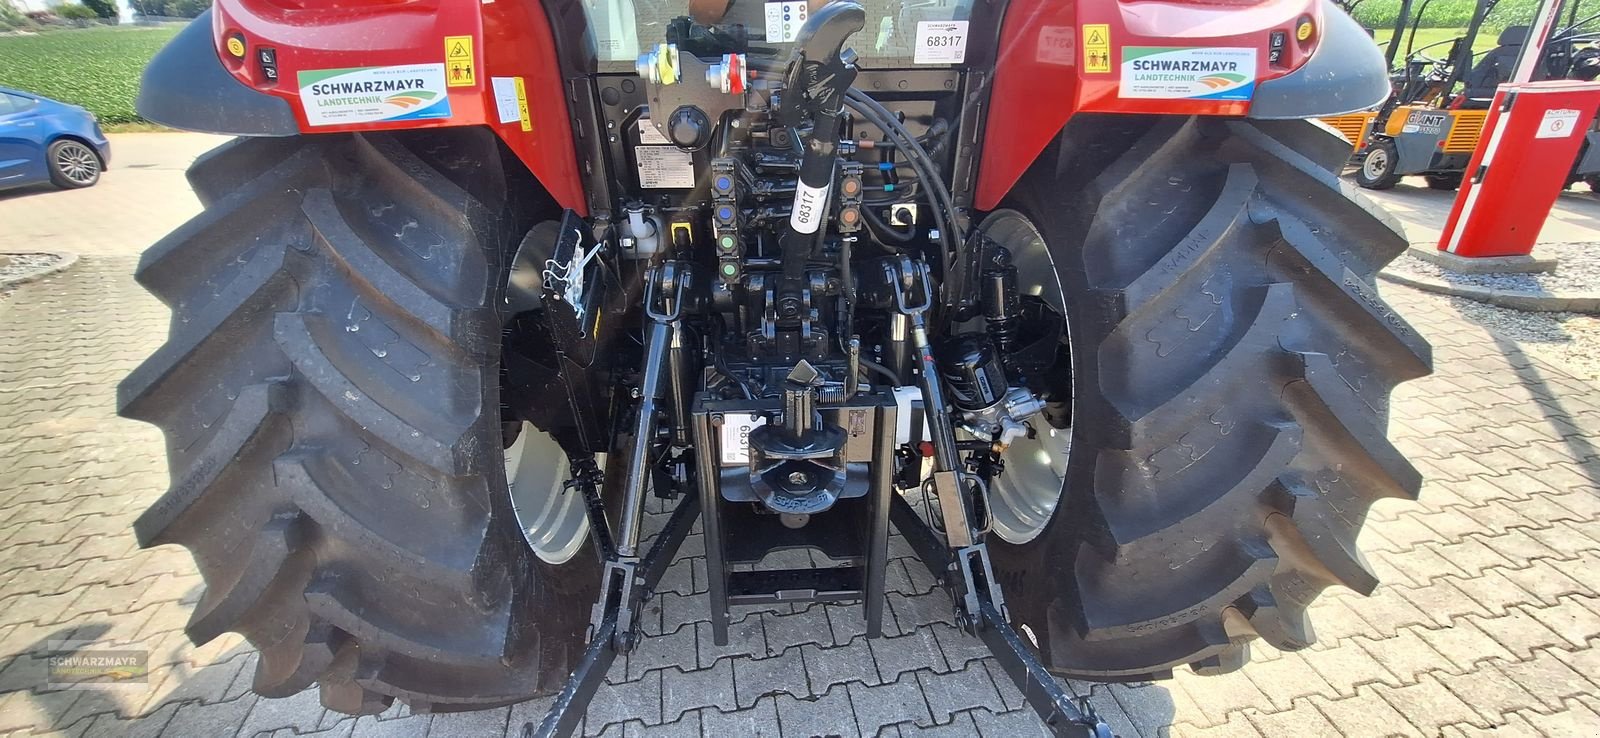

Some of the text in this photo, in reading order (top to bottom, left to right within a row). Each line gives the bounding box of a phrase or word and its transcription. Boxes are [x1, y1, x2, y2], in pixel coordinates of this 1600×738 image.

[927, 36, 961, 46] 68317
[1133, 60, 1237, 71] SCHWARZMAYR
[312, 79, 424, 96] SCHWARZMAYR
[317, 95, 382, 107] LANDTECHNIK
[798, 190, 814, 224] 68317
[740, 425, 751, 457] 68317
